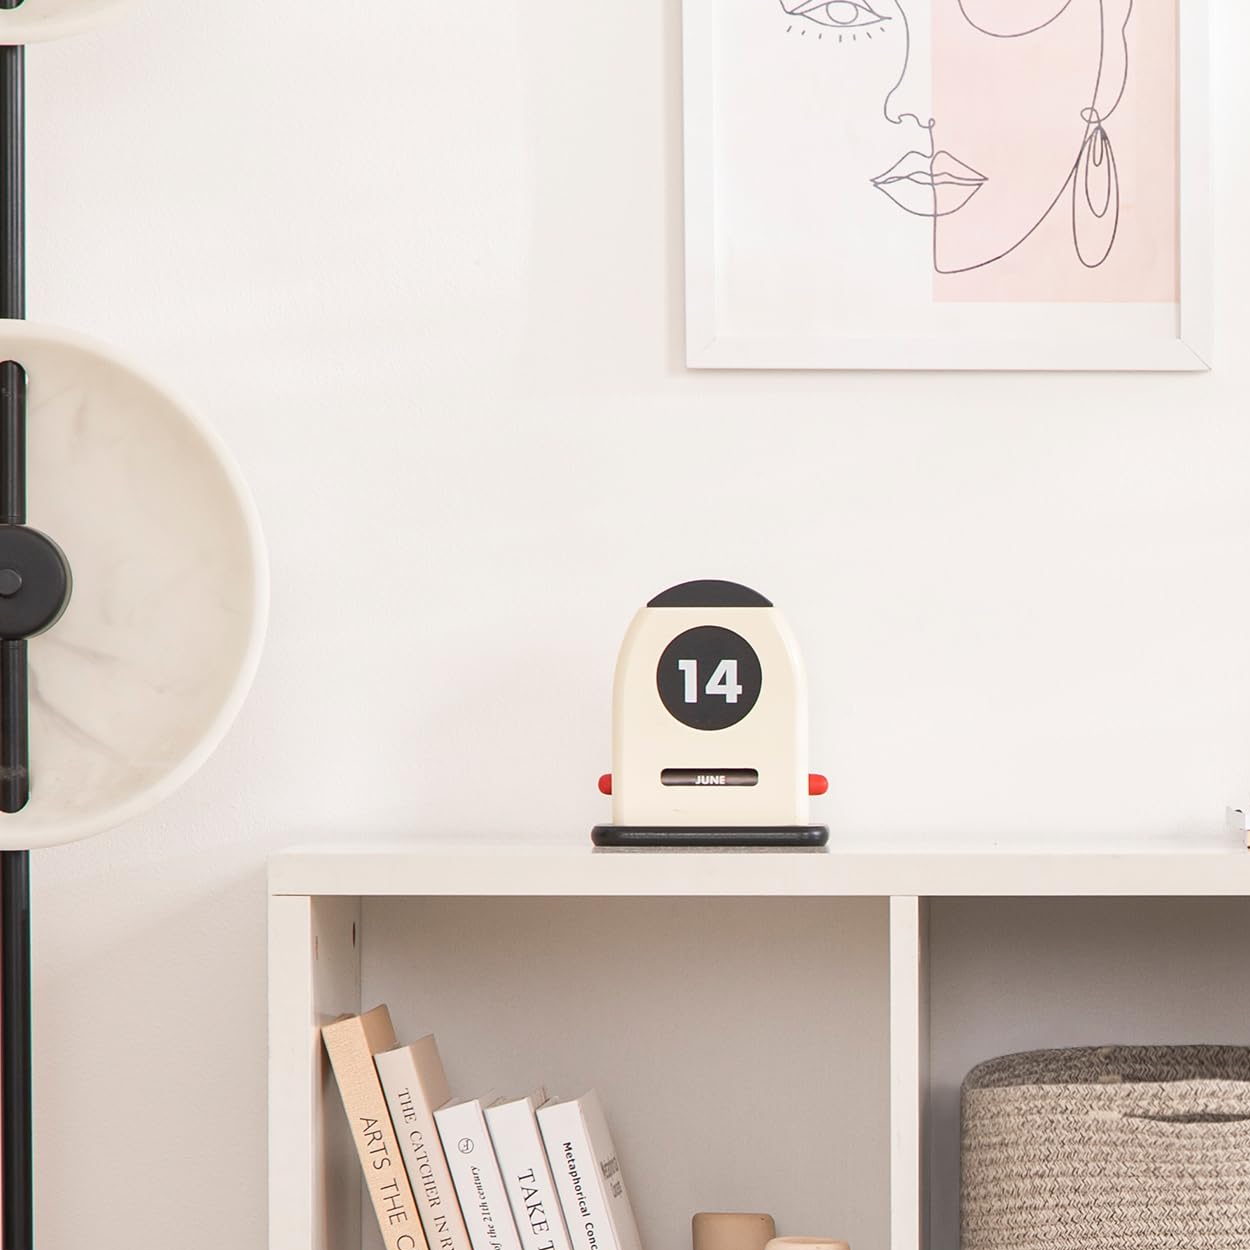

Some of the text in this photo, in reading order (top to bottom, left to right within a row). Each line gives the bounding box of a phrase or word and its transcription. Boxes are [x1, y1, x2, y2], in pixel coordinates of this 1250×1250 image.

[678, 659, 742, 702] 14
[694, 775, 725, 785] JUNE
[359, 1117, 391, 1170] ARTS
[380, 1178, 408, 1225] THE
[398, 1088, 417, 1124] THE
[409, 1130, 441, 1209] CATCHER
[433, 1215, 449, 1234] IN
[563, 1141, 590, 1217] Metaphorical
[470, 1165, 486, 1202] century
[517, 1168, 550, 1236] TAKE
[479, 1202, 492, 1222] 21th
[486, 1224, 497, 1238] the
